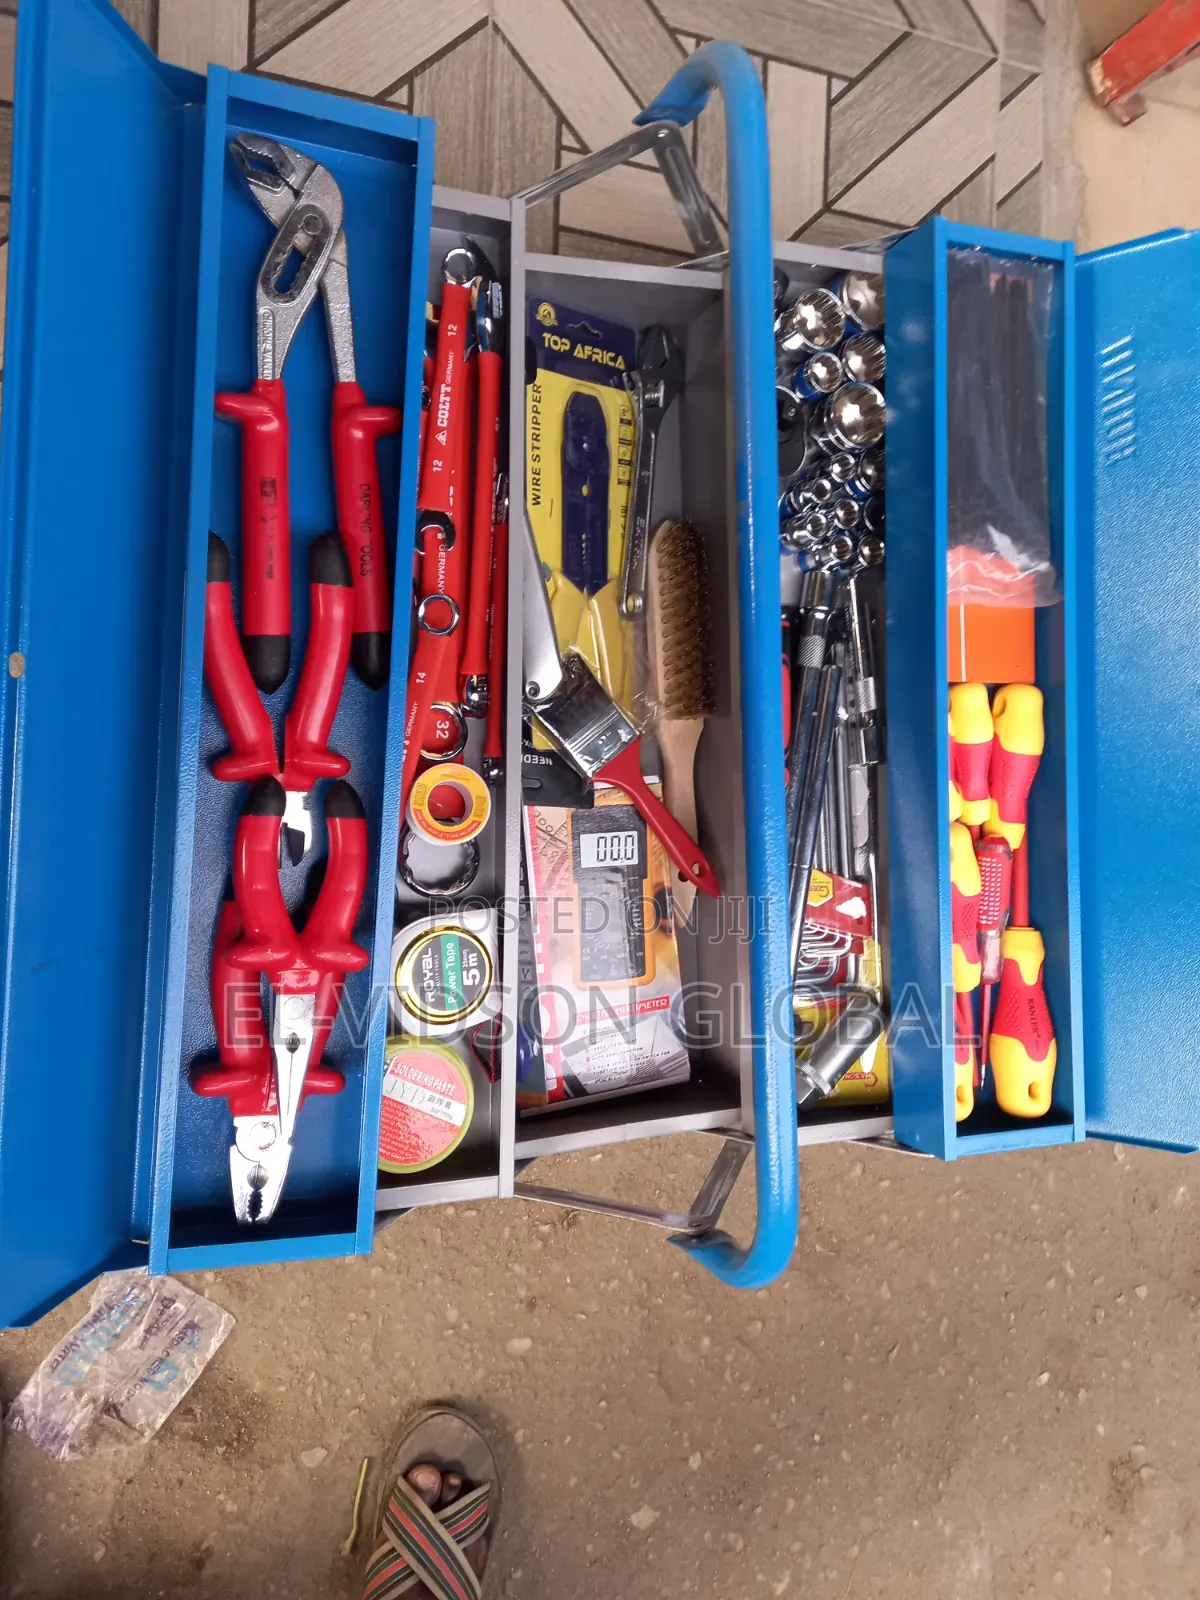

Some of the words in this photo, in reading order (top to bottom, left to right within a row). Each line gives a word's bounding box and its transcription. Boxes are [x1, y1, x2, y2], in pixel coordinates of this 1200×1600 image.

[447, 324, 458, 337] 12
[444, 351, 455, 385] GERMANY
[542, 332, 571, 352] TOP
[573, 342, 626, 371] AFRICA
[532, 383, 543, 464] STRIPPER
[433, 459, 443, 472] 12
[531, 466, 542, 507] WIRE
[438, 545, 448, 594] GERMANY
[415, 671, 427, 684] 14
[405, 701, 419, 737] GERMANY
[436, 720, 449, 739] 32
[445, 942, 456, 968] Tape
[421, 947, 435, 1003] ROYAL
[447, 969, 458, 1004] Power
[394, 1062, 435, 1090] SOLDERING
[433, 1078, 456, 1097] PASTE
